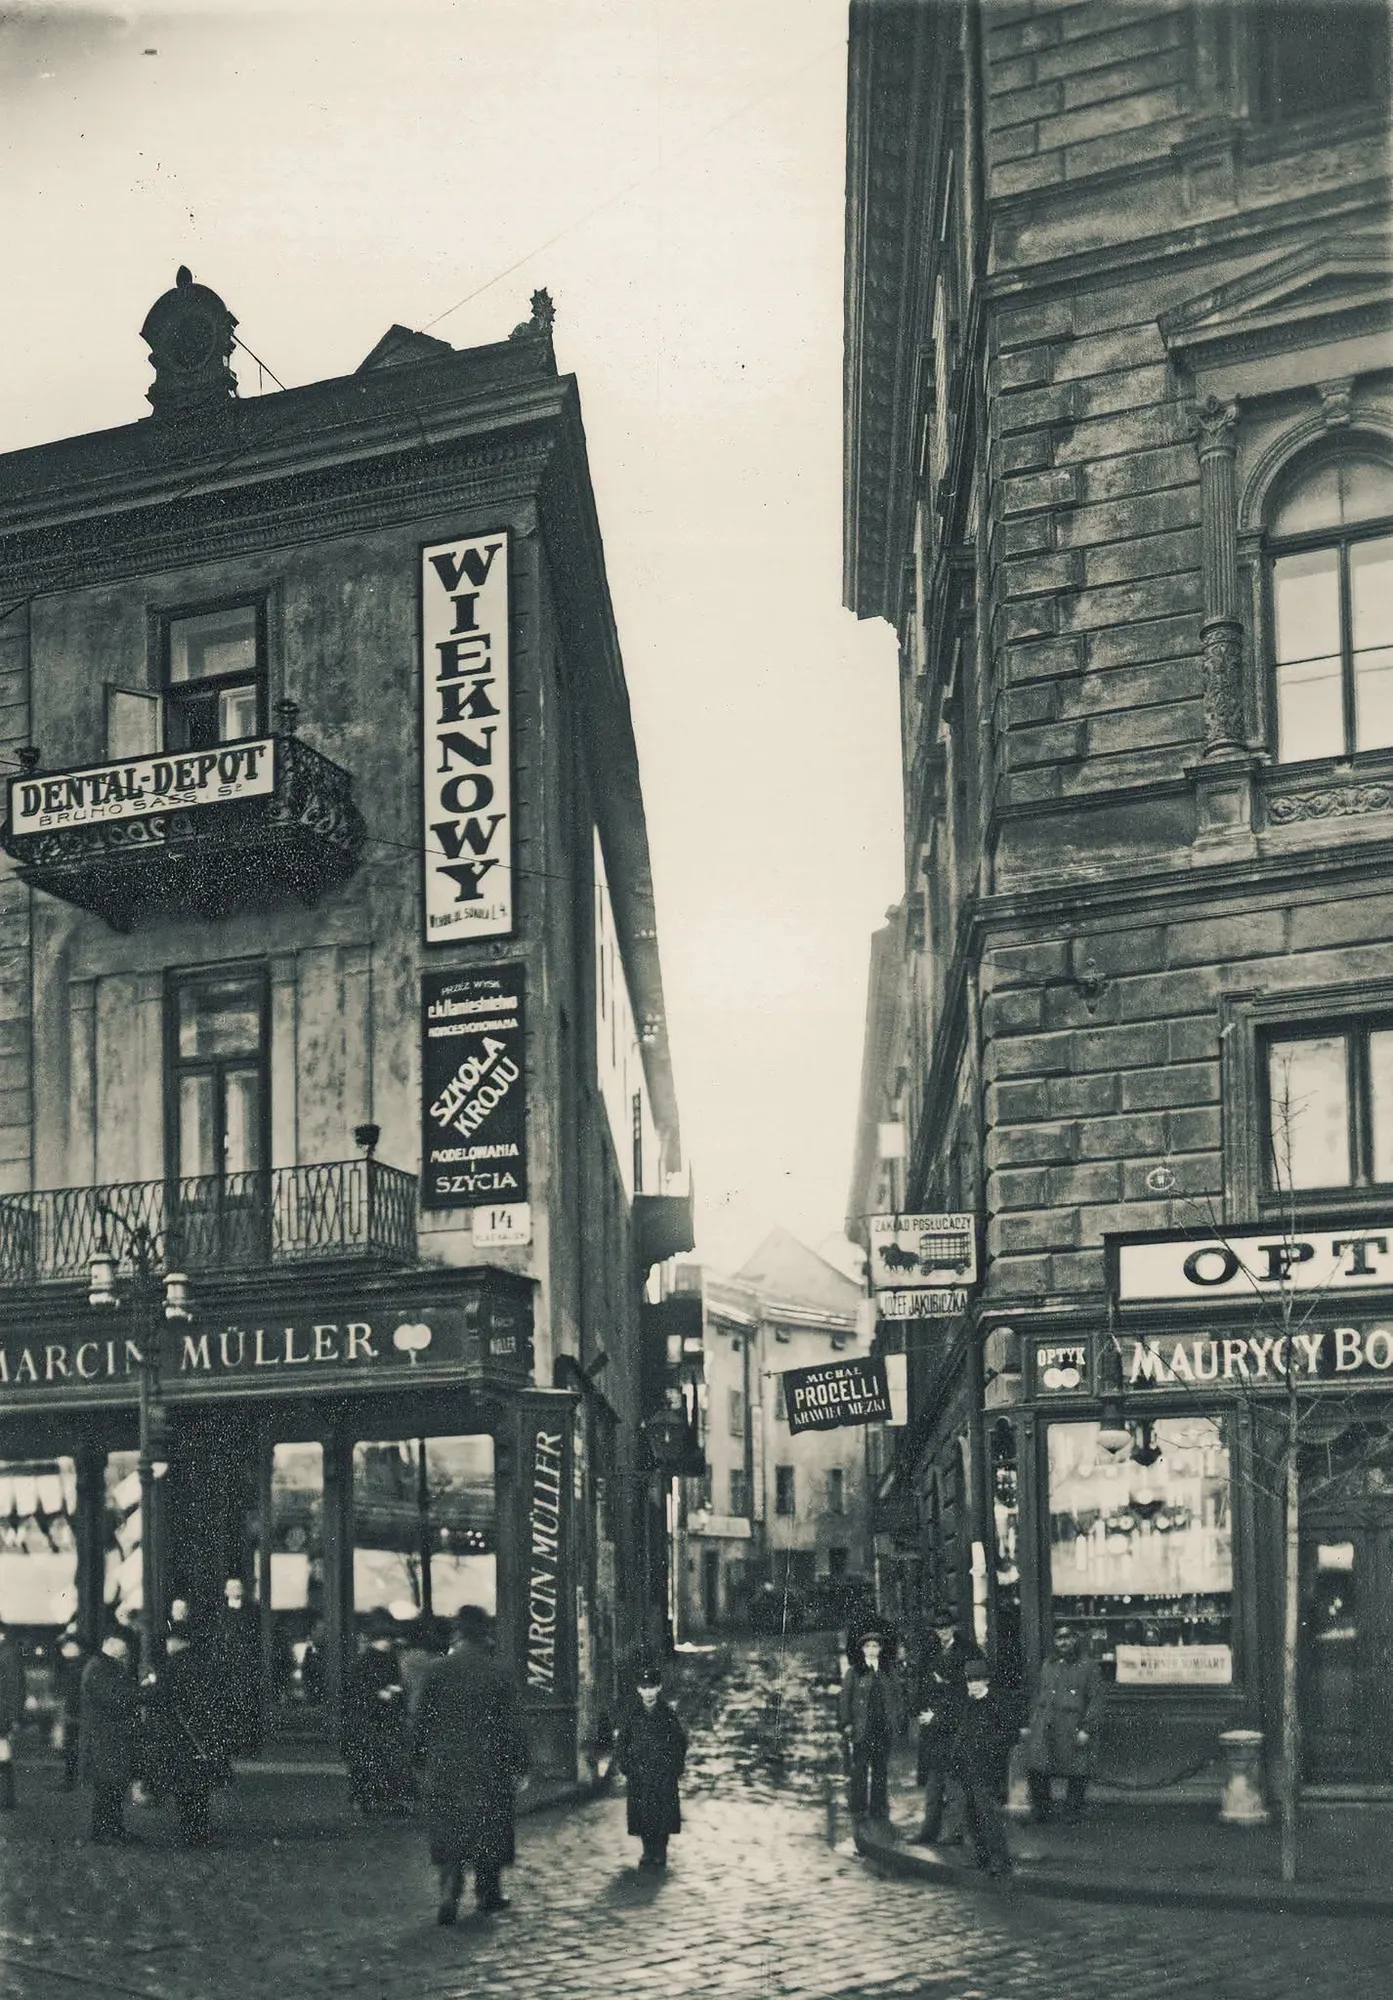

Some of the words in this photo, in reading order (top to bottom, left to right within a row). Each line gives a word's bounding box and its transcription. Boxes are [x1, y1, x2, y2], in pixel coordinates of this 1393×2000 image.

[20, 744, 266, 817] DENTAL-DEPOT
[39, 803, 123, 827] BRUNO
[430, 1036, 506, 1128] SZKOŁA
[453, 1056, 520, 1138] KROJU
[430, 1143, 519, 1163] MODELOWANIA
[435, 1172, 518, 1193] SZYCIA
[1183, 1235, 1389, 1286] OPT
[0, 1340, 144, 1383] ARCIN
[181, 1322, 378, 1370] MÜLLER
[1037, 1346, 1086, 1367] OPTYK
[1130, 1333, 1325, 1384] MAURYCY
[794, 1375, 879, 1410] PROCELLI
[530, 1431, 562, 1562] MÜLLER
[527, 1567, 557, 1693] MARCIN
